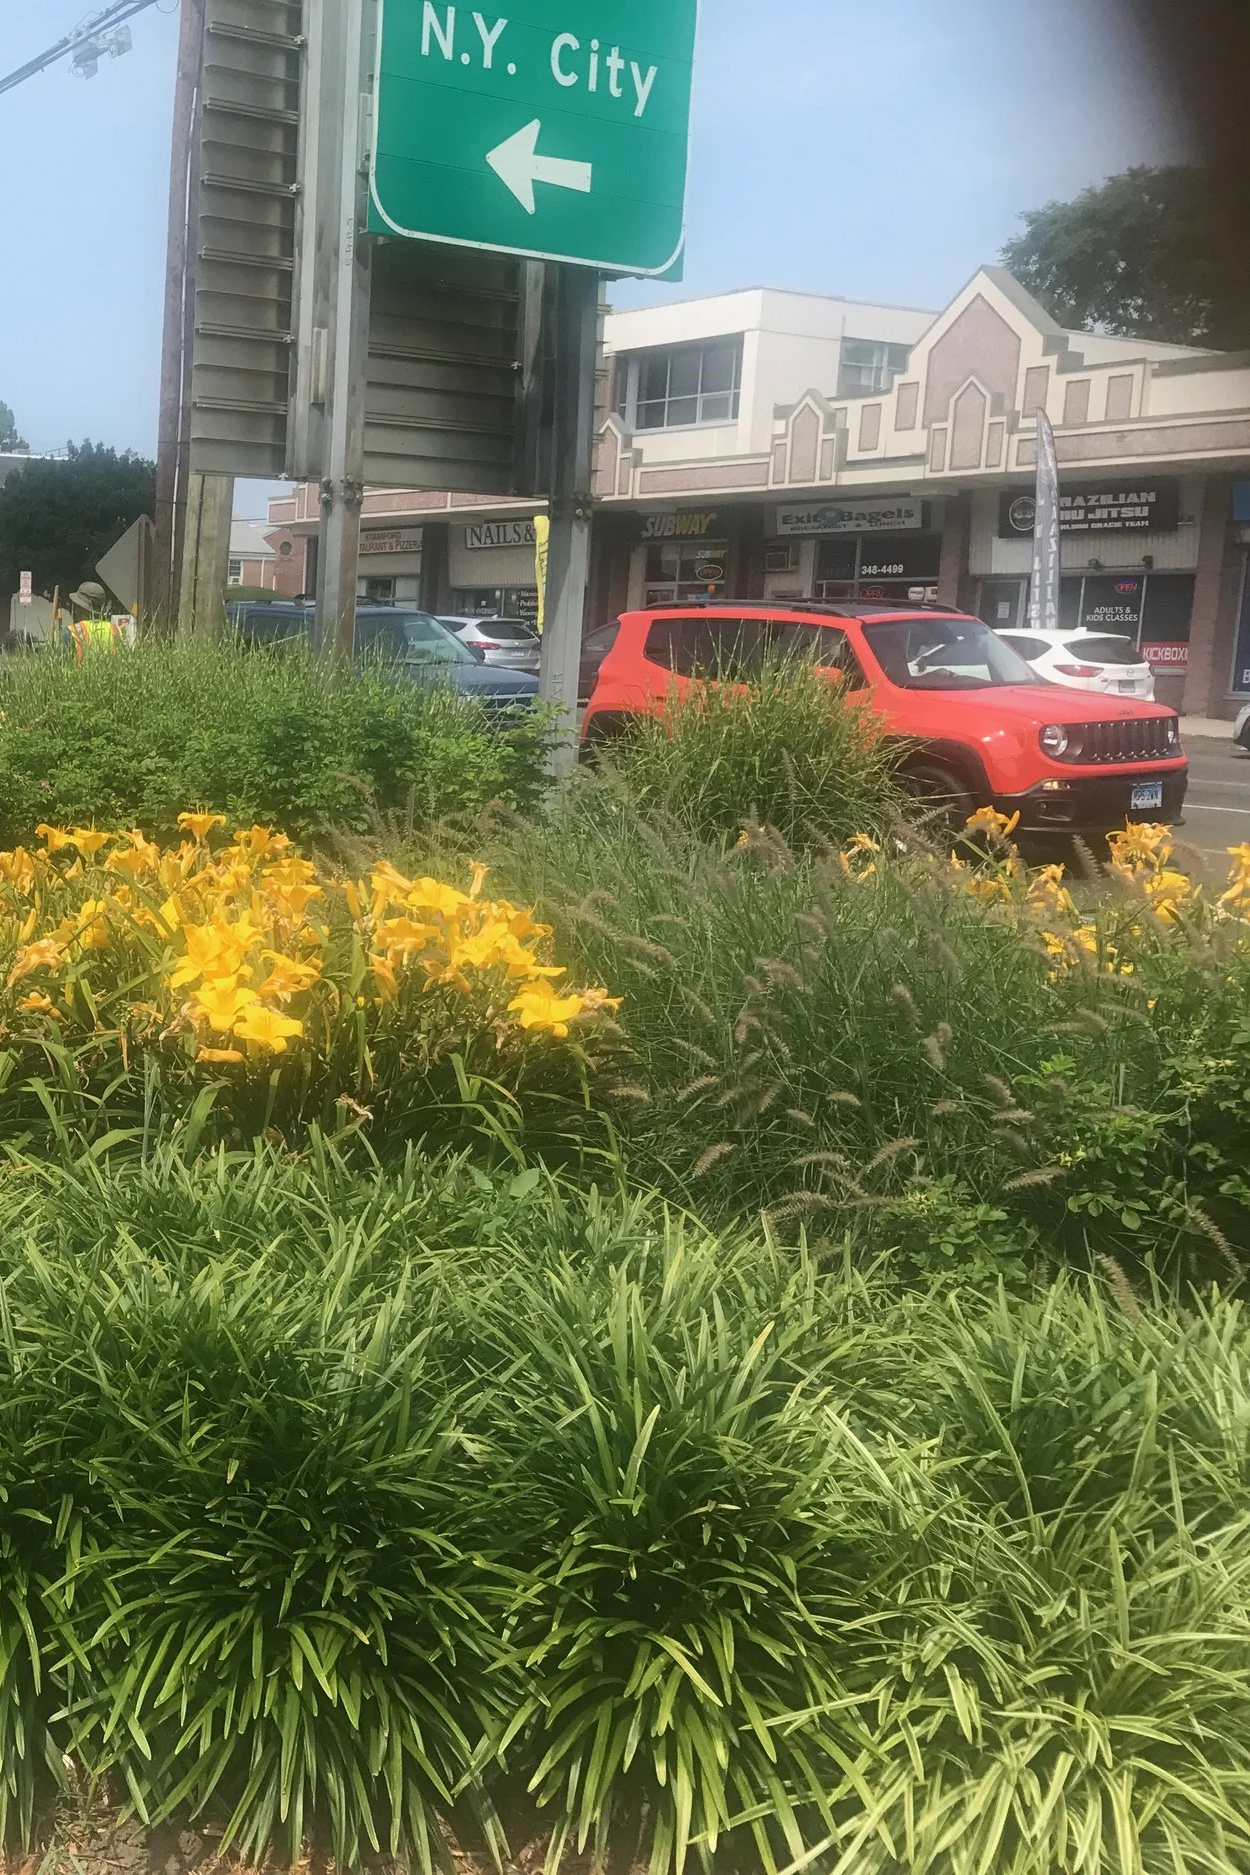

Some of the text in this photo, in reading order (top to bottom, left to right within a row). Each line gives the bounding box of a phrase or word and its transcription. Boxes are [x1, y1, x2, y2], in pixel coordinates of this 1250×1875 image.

[420, 1, 658, 117] N.Y. City
[1060, 491, 1157, 507] RAZILIAN
[782, 513, 821, 526] Exit
[841, 507, 915, 524] Bagels
[1088, 506, 1150, 519] JITSU
[640, 511, 718, 538] SUBWAY
[1124, 520, 1150, 528] TEAM
[469, 524, 536, 547] NAILS &
[861, 563, 904, 575] 348-4499
[1093, 606, 1131, 614] ADULTS &
[1086, 613, 1139, 622] KIDS CLASSES
[1142, 647, 1188, 661] KICKBOXI
